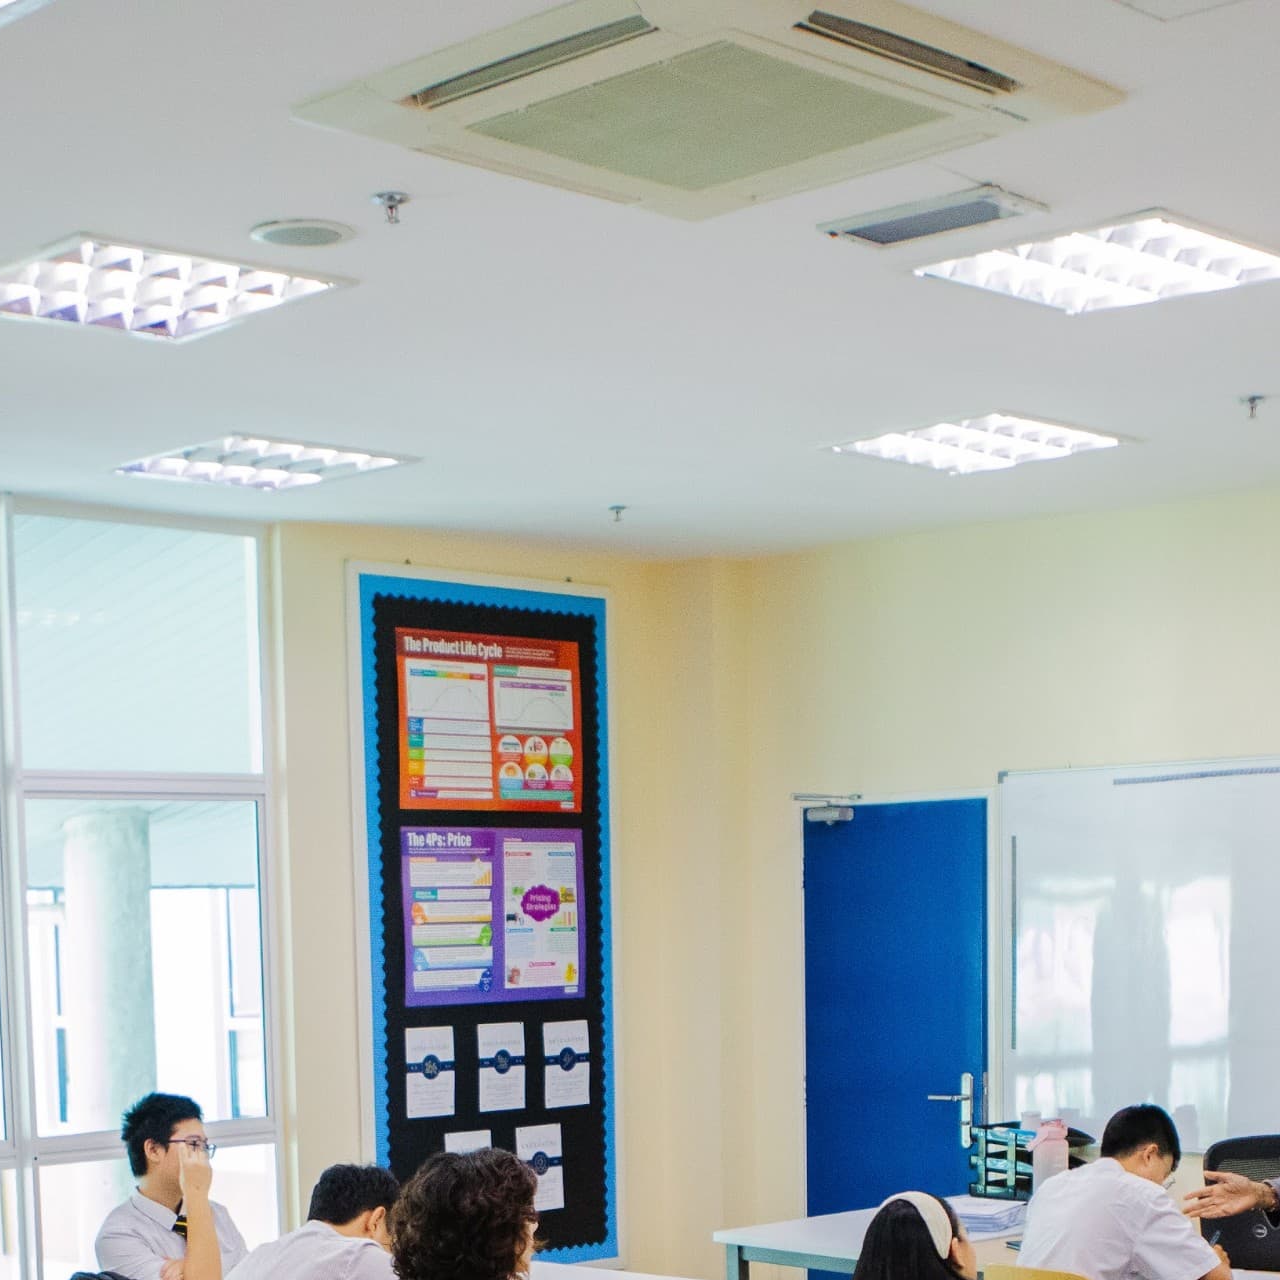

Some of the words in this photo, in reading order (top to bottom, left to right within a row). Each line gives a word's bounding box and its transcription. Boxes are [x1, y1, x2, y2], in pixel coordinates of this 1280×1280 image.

[404, 636, 422, 652] The
[423, 638, 461, 656] Product
[462, 641, 477, 654] Life
[478, 642, 503, 661] Cycle
[407, 832, 425, 847] The
[426, 832, 447, 848] 4Ps:
[447, 832, 472, 847] Price
